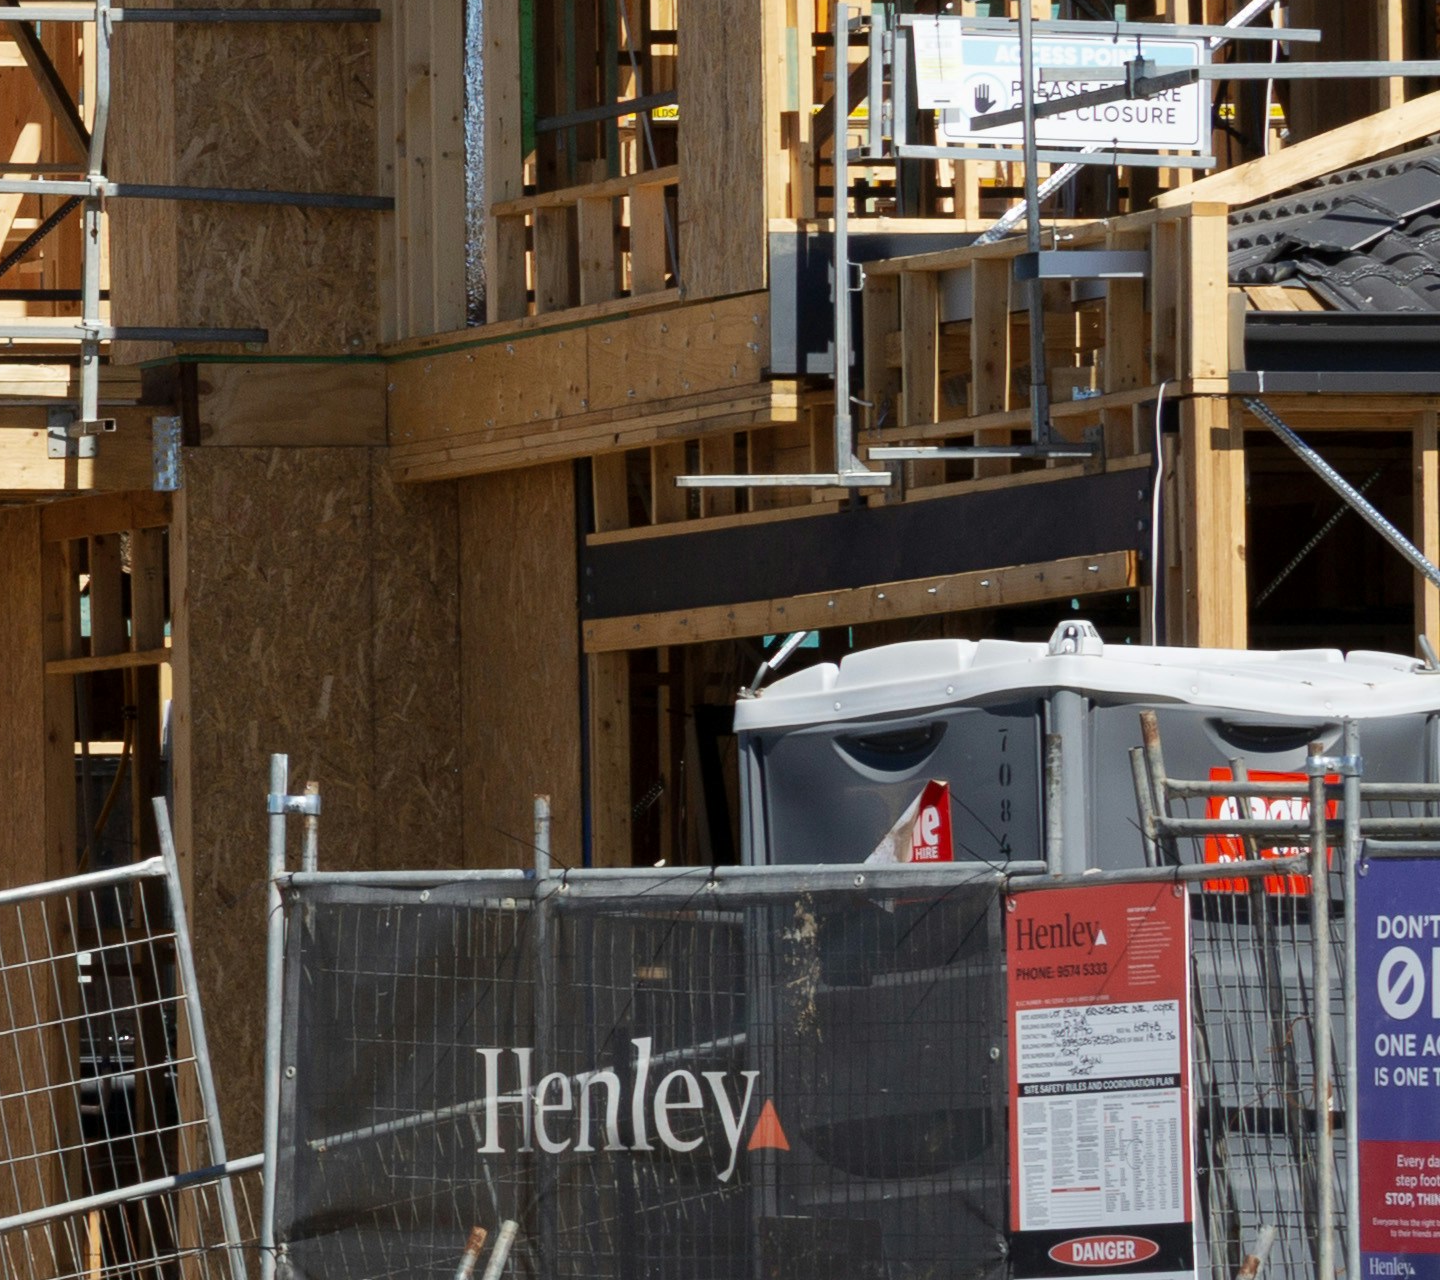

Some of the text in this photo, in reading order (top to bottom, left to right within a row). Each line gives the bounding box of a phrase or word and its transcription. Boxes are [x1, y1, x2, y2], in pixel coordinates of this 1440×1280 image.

[1076, 105, 1176, 125] CLOSURE
[1016, 914, 1100, 955] Henley
[1083, 963, 1108, 976] 5333
[1375, 1034, 1417, 1056] ONE
[1024, 1076, 1175, 1095] SITE SAFETY RULES AND COORDINATION PLAN
[1375, 1067, 1429, 1086] IS ONE
[476, 1036, 760, 1182] Henley
[1396, 1154, 1425, 1170] Every
[1396, 1174, 1418, 1189] step
[1385, 1192, 1415, 1208] STOP,
[1072, 1240, 1136, 1262] DANGER
[1370, 1257, 1412, 1280] Henley
